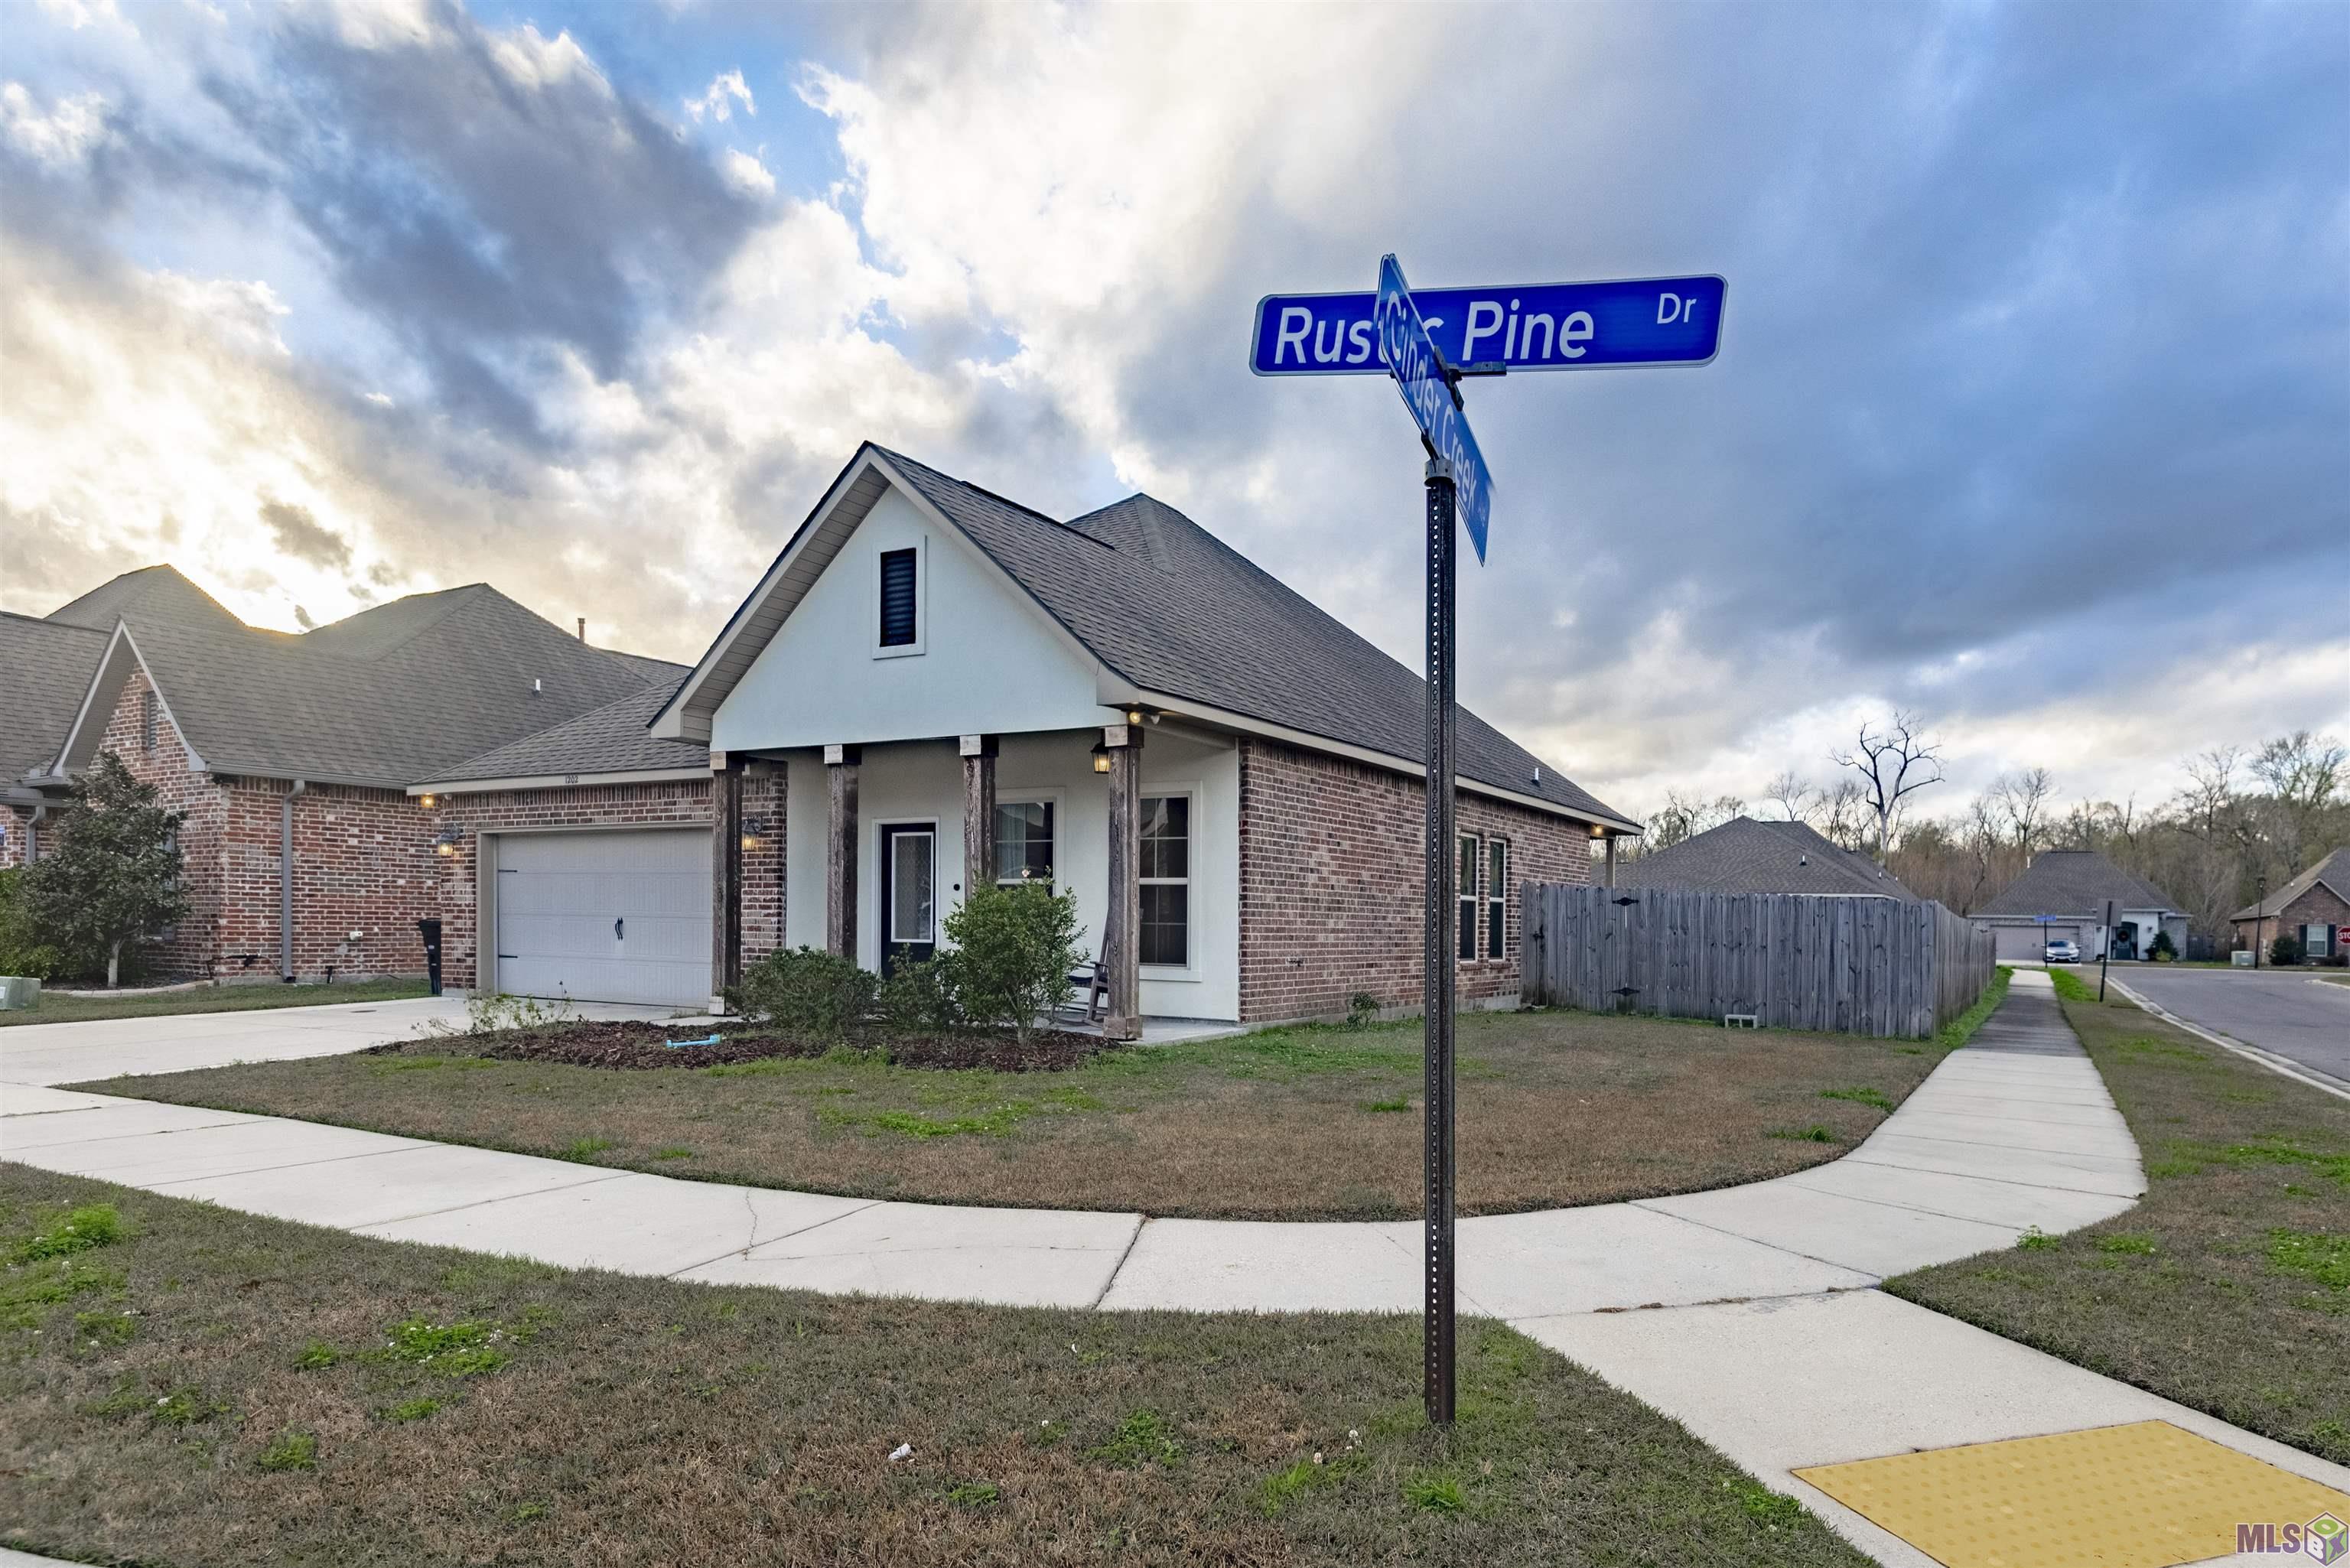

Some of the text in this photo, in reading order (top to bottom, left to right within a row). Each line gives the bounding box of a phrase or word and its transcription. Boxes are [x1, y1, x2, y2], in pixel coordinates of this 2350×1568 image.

[1462, 298, 1594, 361] Pine
[1657, 293, 1697, 324] Dr
[1385, 290, 1477, 517] Cinder Creek
[565, 775, 579, 784] 1202
